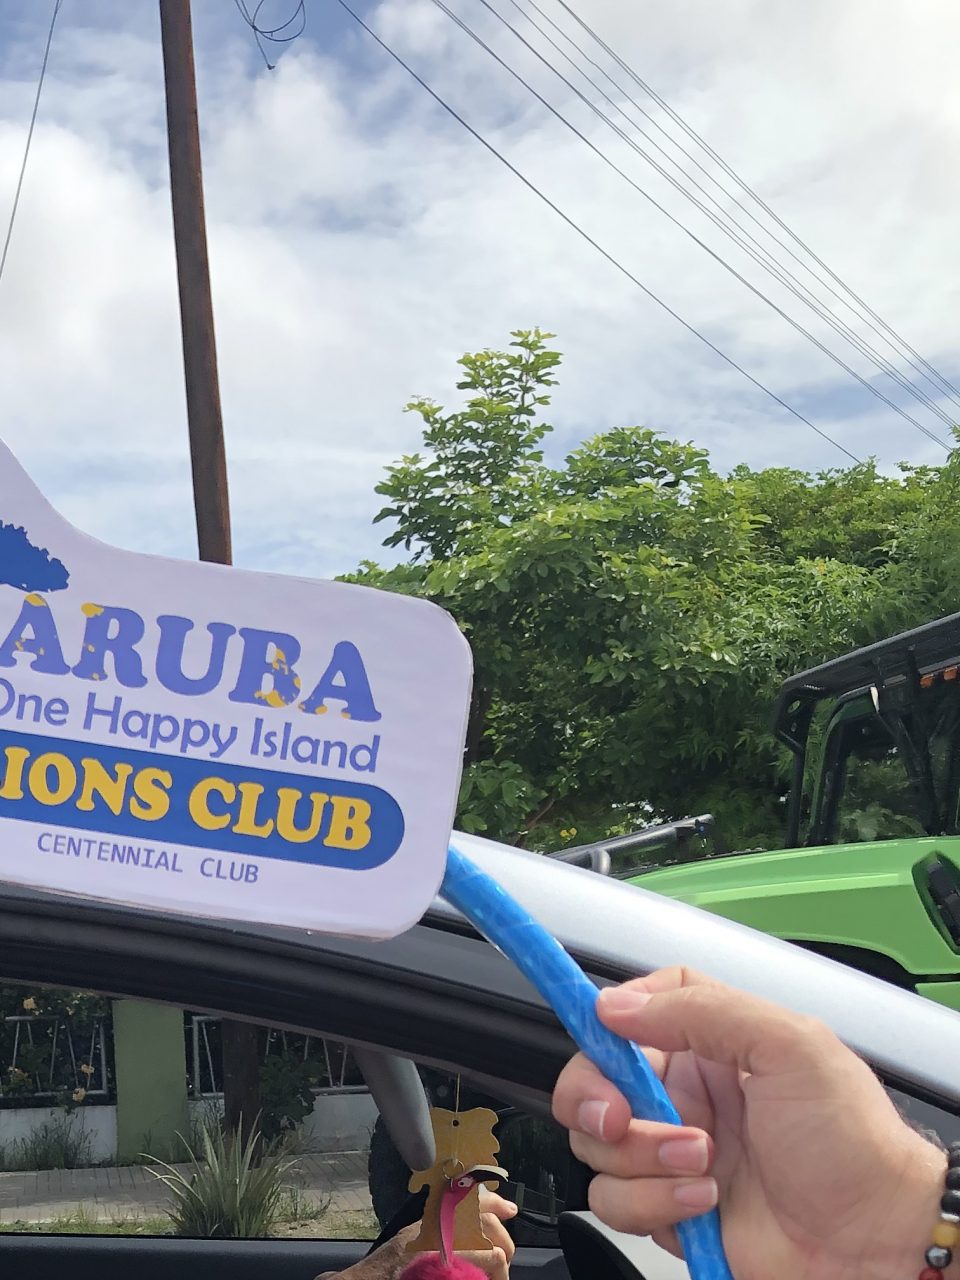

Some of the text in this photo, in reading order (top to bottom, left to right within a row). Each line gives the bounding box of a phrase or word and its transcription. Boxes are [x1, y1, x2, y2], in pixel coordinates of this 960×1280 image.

[82, 694, 238, 758] Happy
[249, 716, 382, 774] Island
[188, 776, 373, 851] CLUB
[36, 832, 260, 884] CENTENNIAL CLUB
